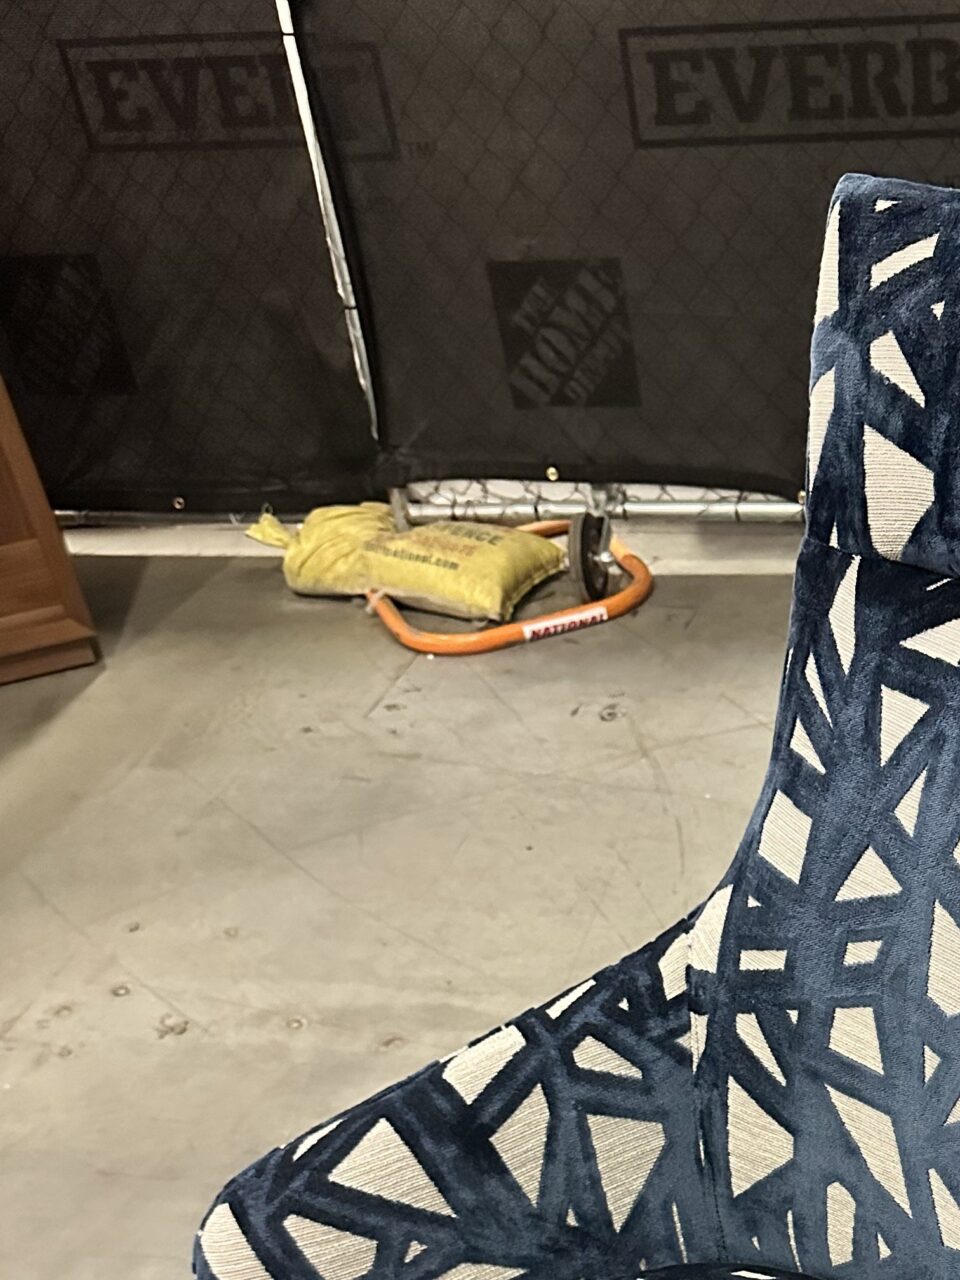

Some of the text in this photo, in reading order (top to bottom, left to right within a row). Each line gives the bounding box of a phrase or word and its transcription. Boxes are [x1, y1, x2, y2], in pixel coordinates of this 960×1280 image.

[509, 267, 619, 404] HOME
[511, 275, 559, 337] THE
[563, 315, 631, 406] DEPOT
[531, 613, 605, 641] NATIONAL
